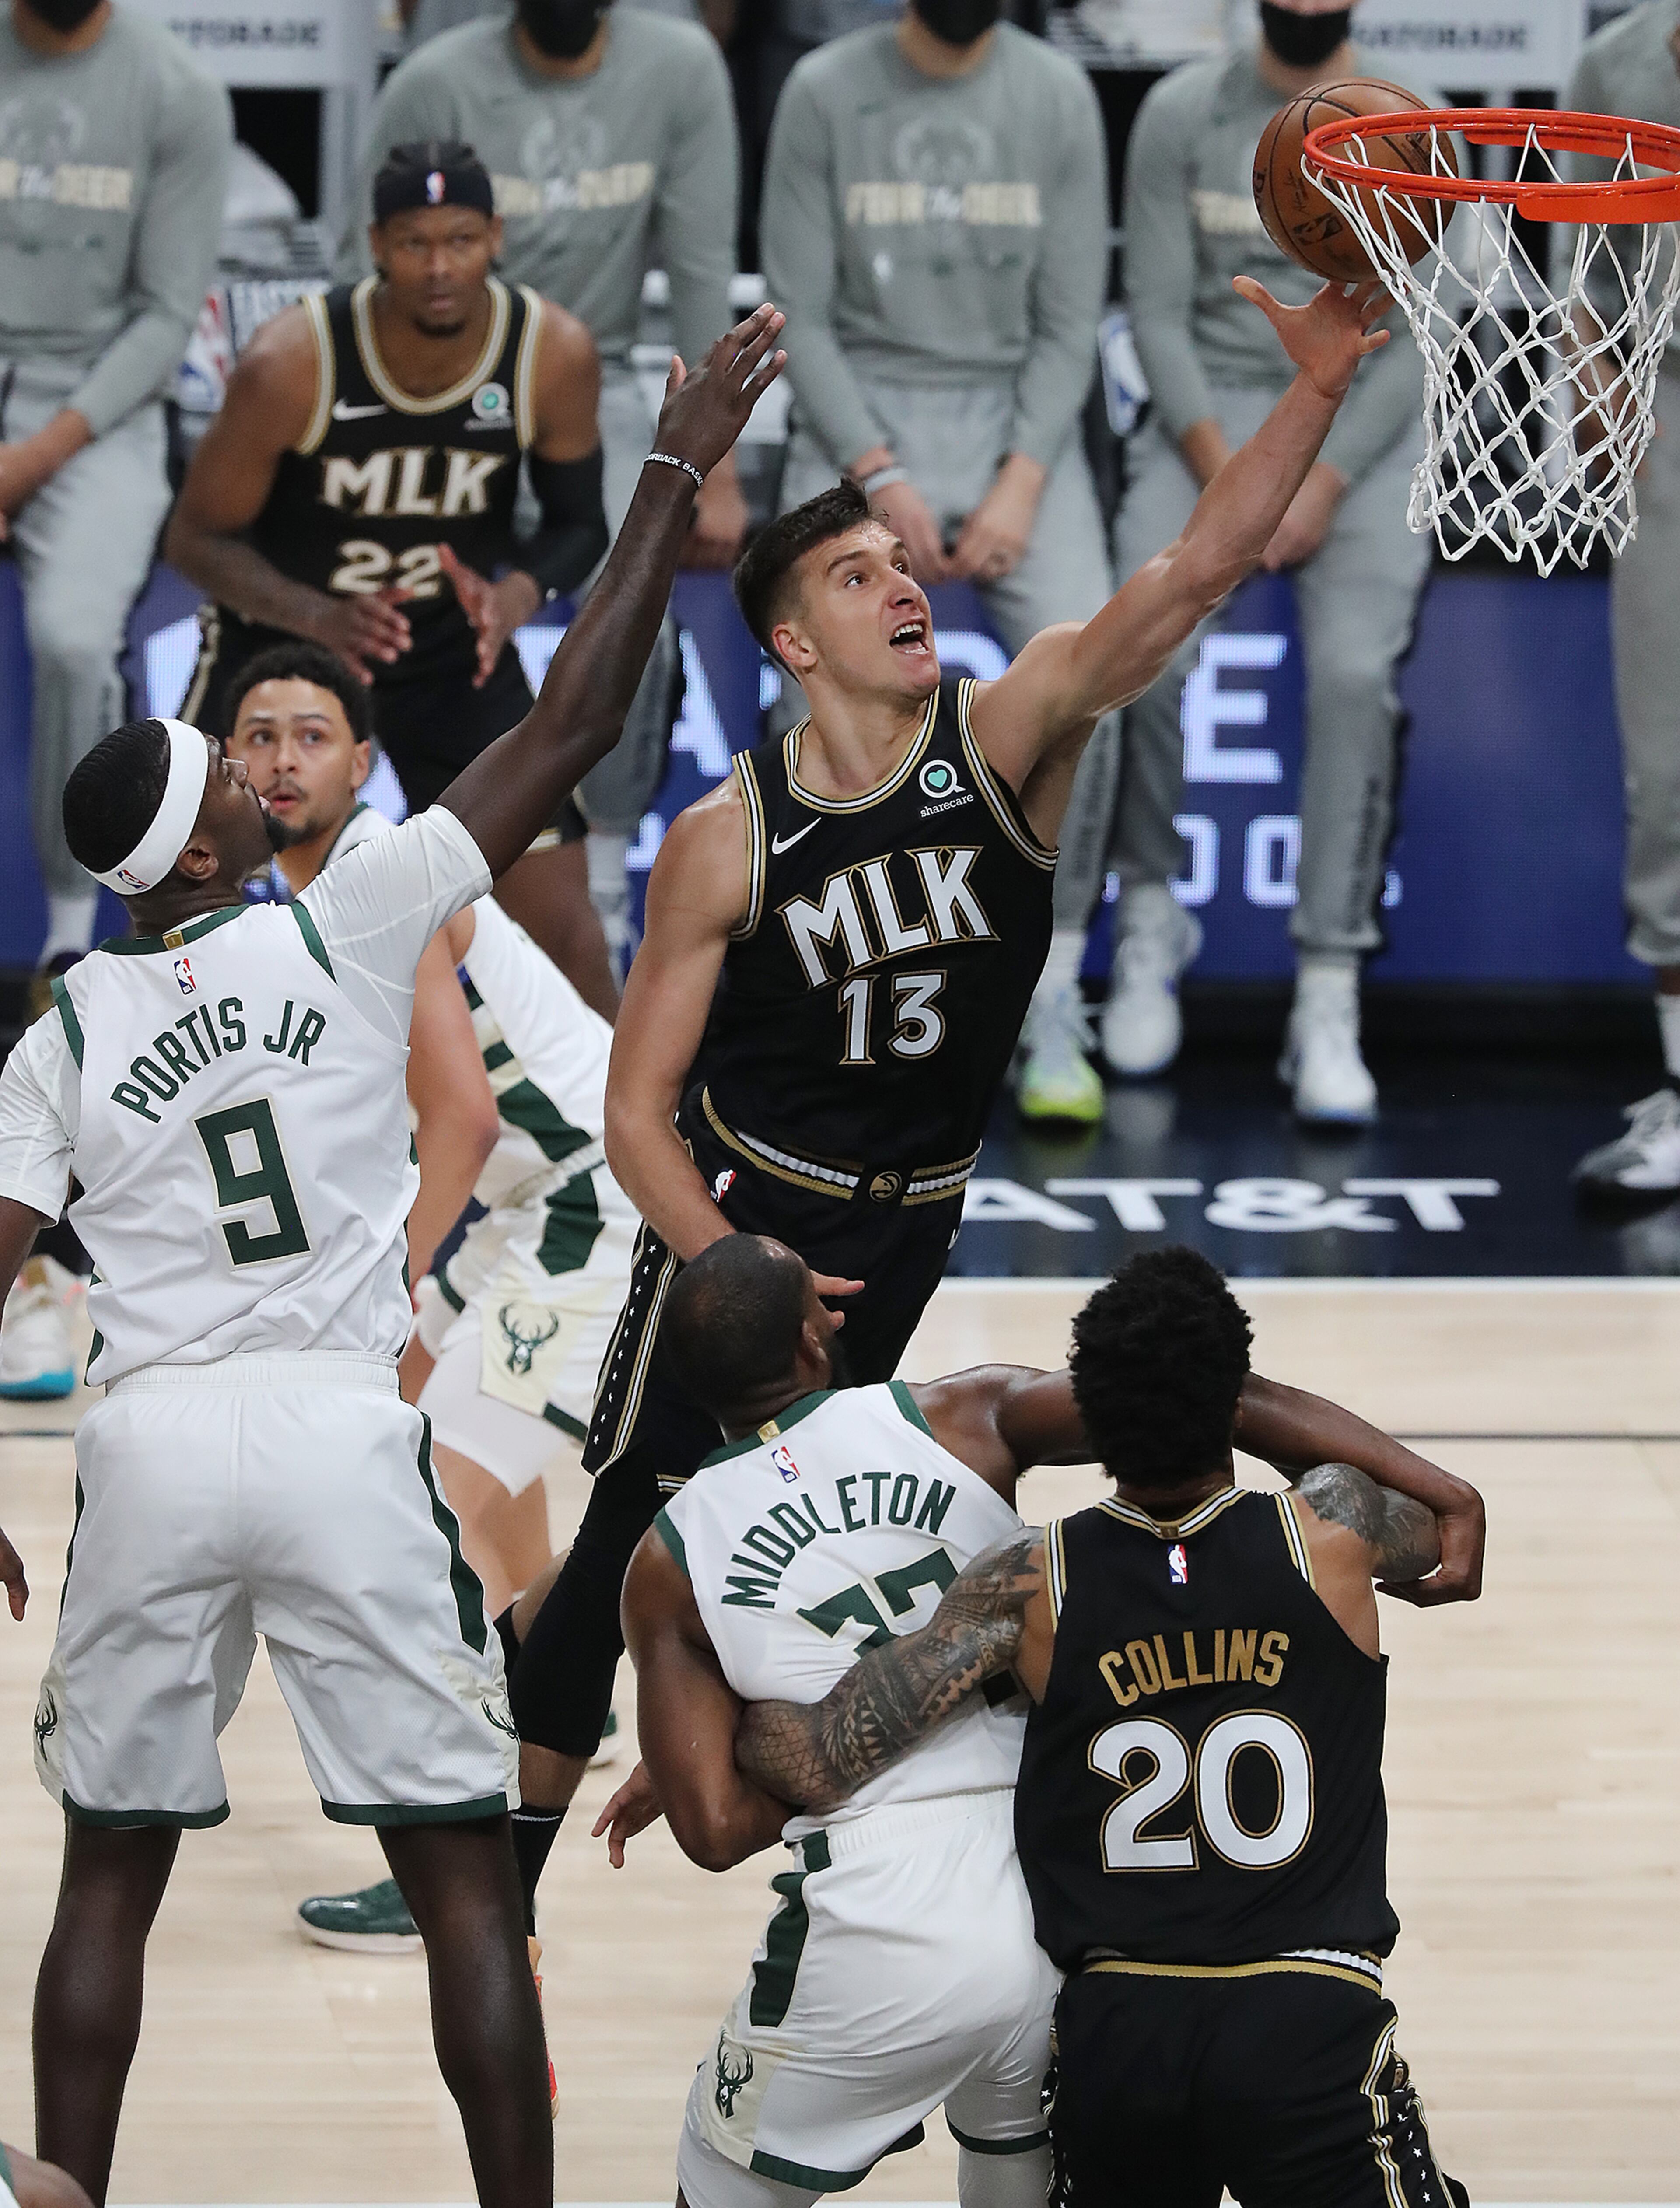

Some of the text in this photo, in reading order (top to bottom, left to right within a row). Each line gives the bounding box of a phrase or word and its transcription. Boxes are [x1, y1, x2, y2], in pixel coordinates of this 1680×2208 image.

[318, 445, 509, 518] MLK
[645, 453, 681, 466] ORBACK
[328, 539, 442, 599] 22
[920, 794, 974, 817] sharecare
[774, 846, 1001, 990] MLK
[838, 969, 947, 1064] 13
[110, 997, 326, 1123] PORTIS JR
[190, 1093, 315, 1270] 9
[963, 1177, 1500, 1232] AT&T
[721, 1471, 956, 1609] MIDDLETON
[1098, 1629, 1290, 1707] COLLINS
[1088, 1708, 1314, 1873] 20
